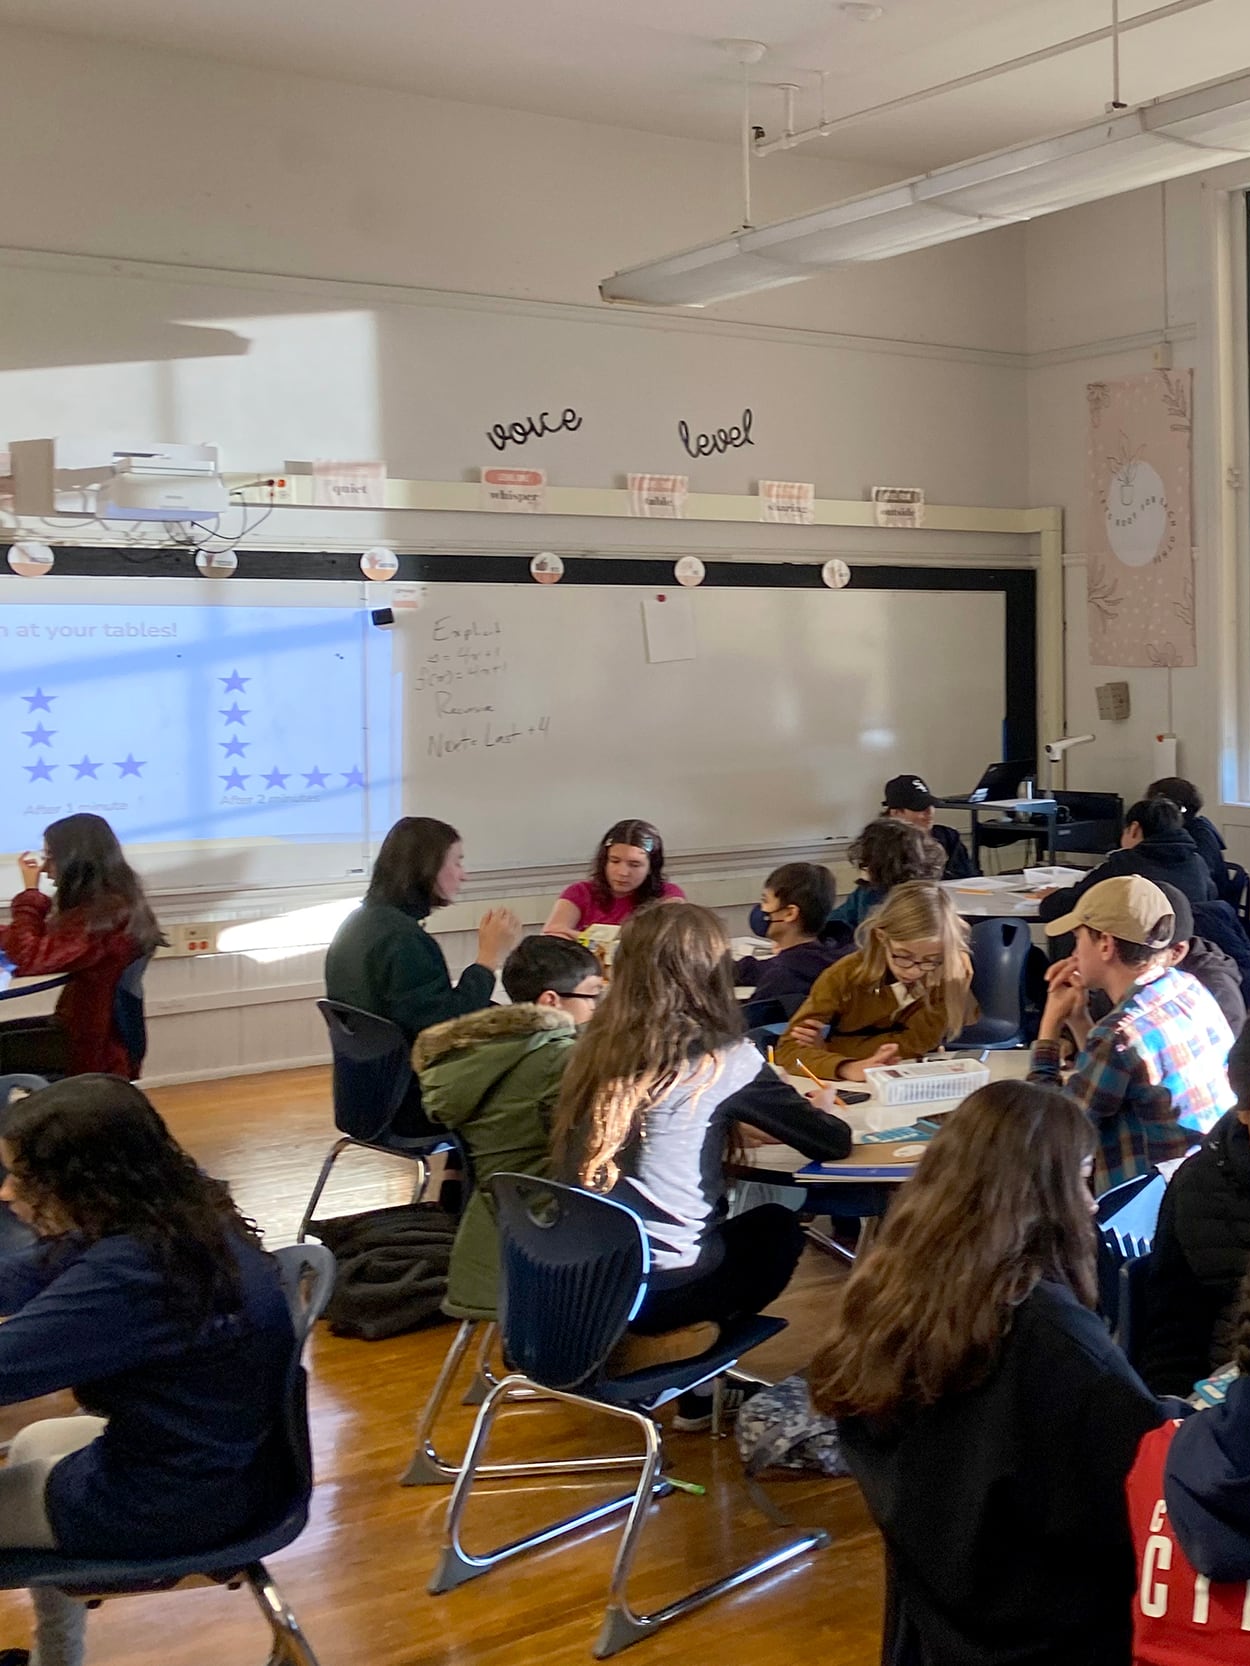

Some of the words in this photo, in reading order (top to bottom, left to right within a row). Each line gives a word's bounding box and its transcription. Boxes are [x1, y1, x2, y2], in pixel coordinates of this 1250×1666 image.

[486, 408, 583, 451] voice
[678, 408, 755, 458] level
[332, 482, 368, 497] quiet
[489, 489, 539, 504] whisper
[16, 623, 41, 638] at
[45, 625, 98, 641] your
[104, 622, 178, 638] tables!
[257, 793, 266, 804] 2
[66, 802, 74, 813] 1
